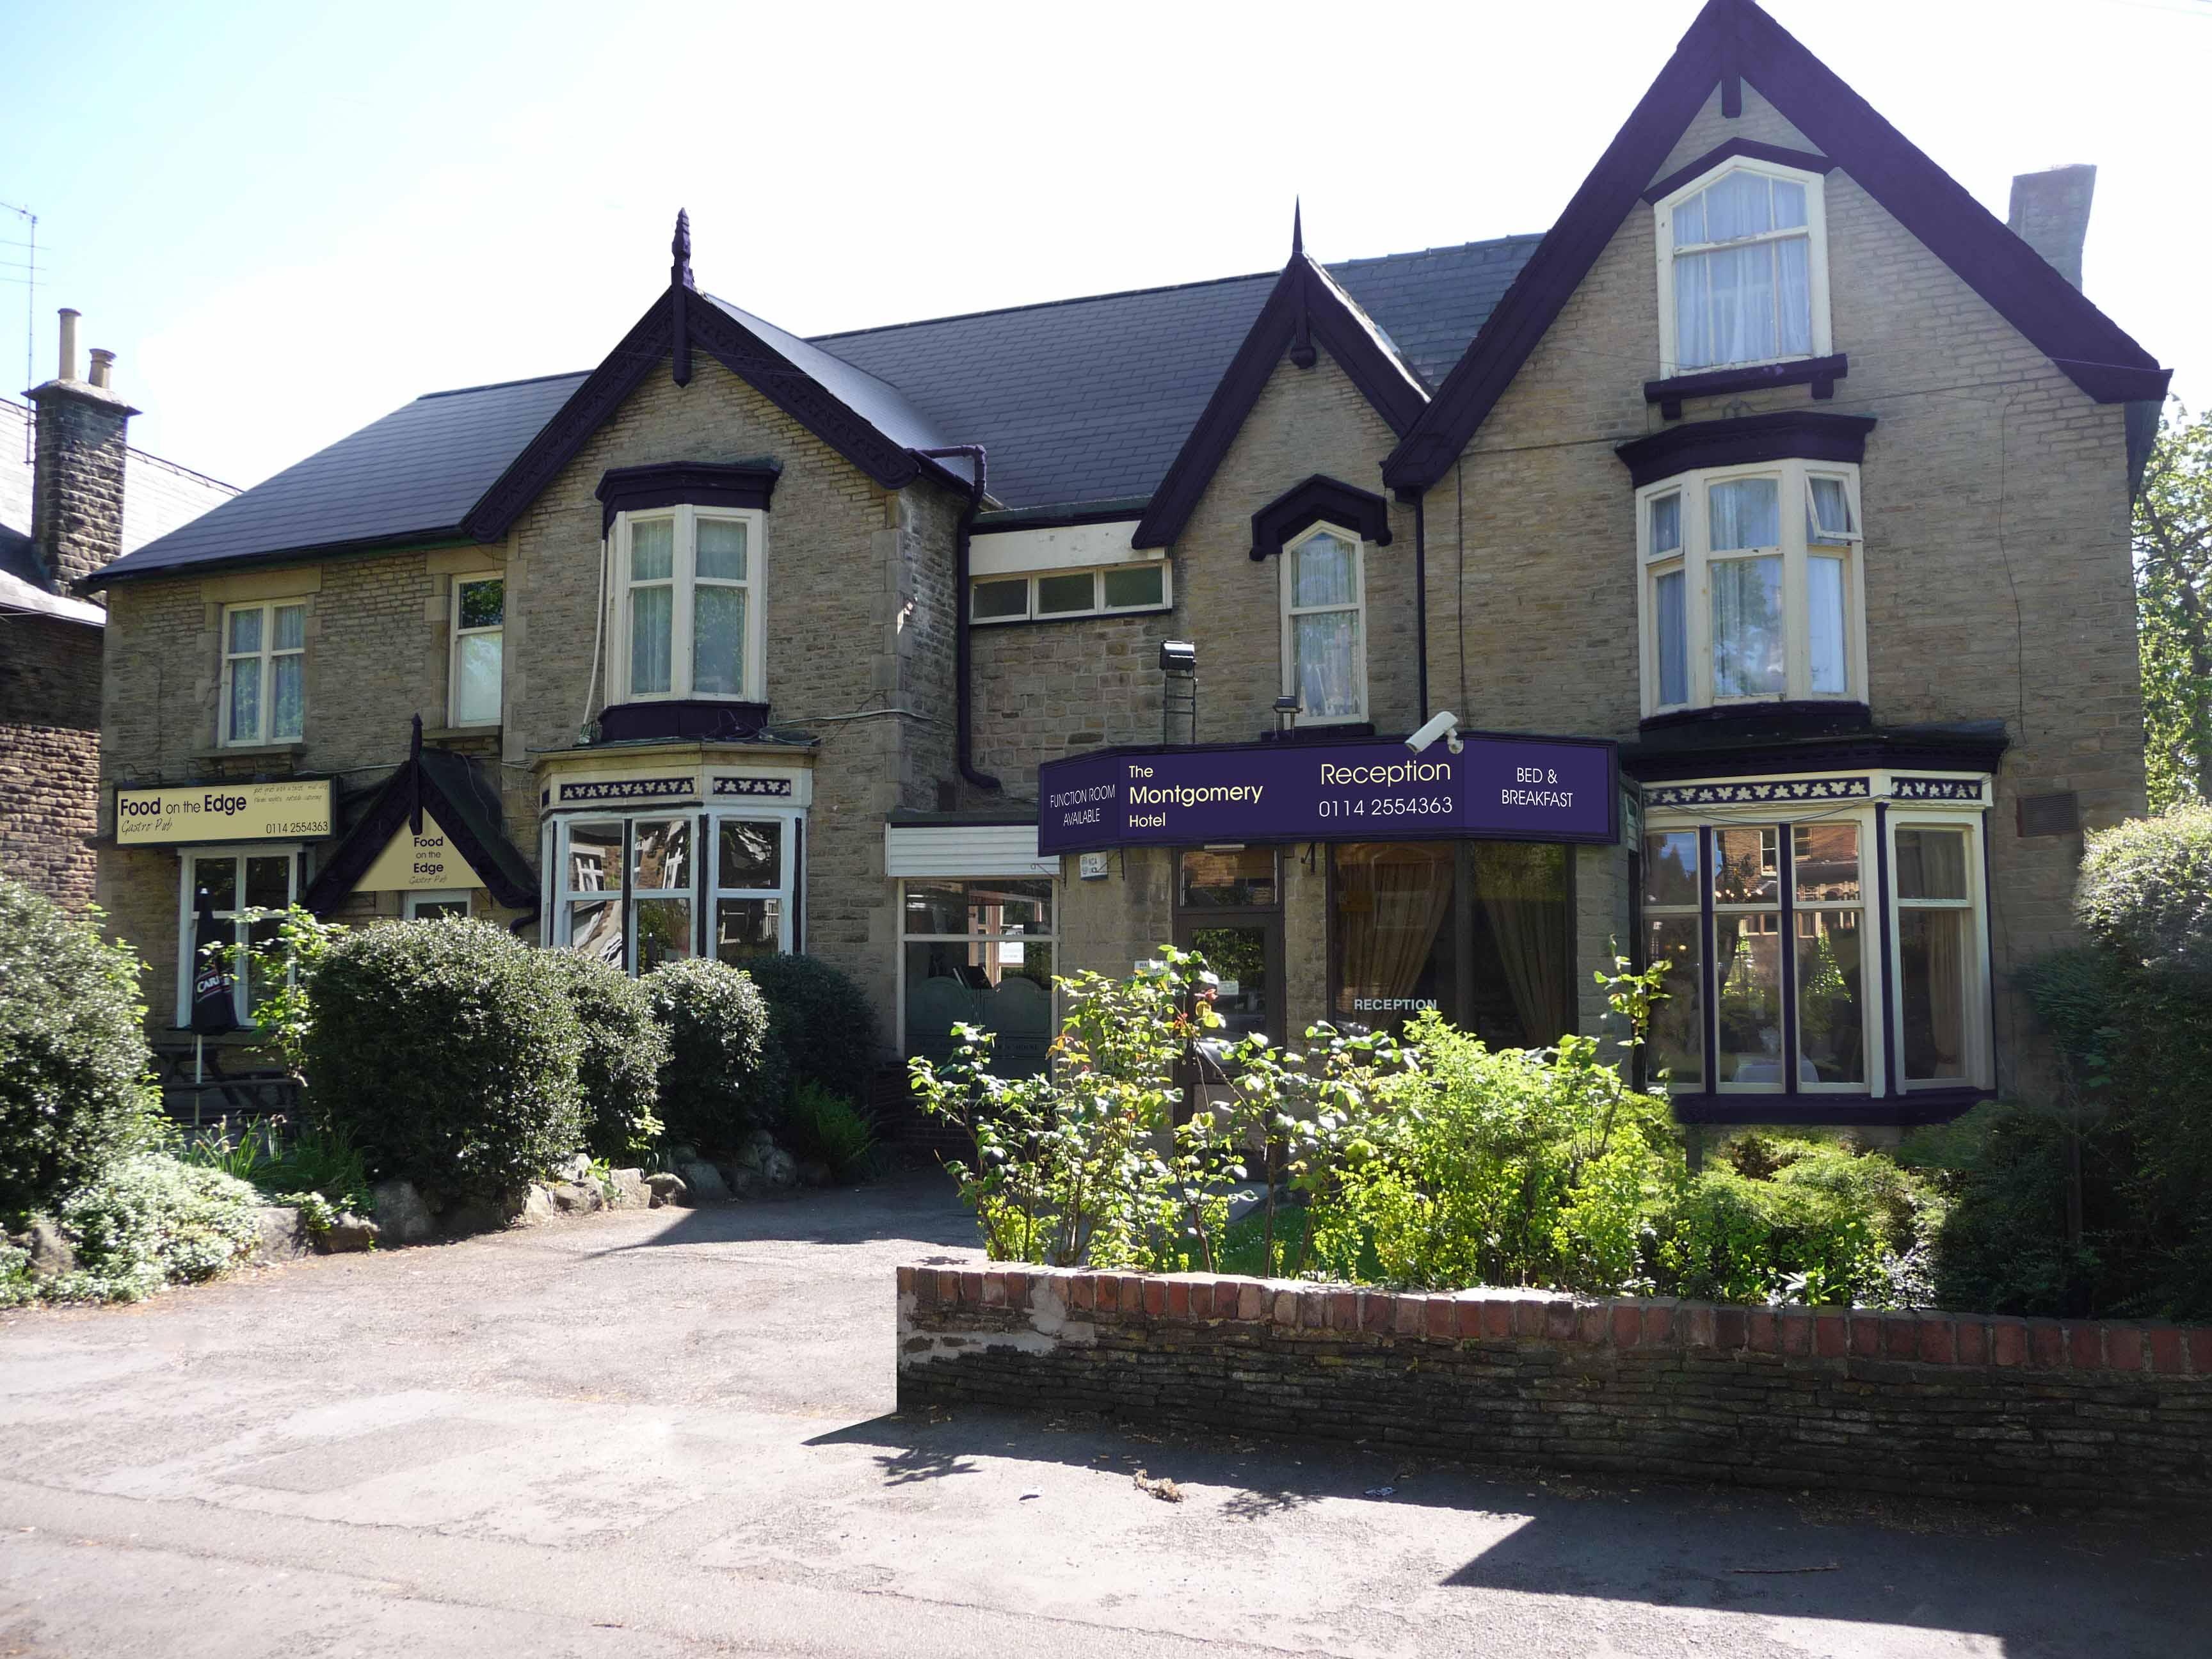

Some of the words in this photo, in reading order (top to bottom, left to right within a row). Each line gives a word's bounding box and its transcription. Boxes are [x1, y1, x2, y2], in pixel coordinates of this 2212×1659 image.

[1128, 765, 1153, 778] The
[1320, 760, 1451, 787] Reception
[1517, 767, 1543, 783] BED
[1547, 769, 1558, 784] &
[120, 797, 161, 816] Food
[166, 803, 180, 814] on
[183, 801, 201, 813] the
[204, 794, 247, 816] Edge
[1050, 789, 1087, 808] FUNCTION
[1089, 784, 1115, 801] ROOM
[1129, 785, 1263, 807] Montgomery
[1502, 789, 1573, 807] BREAKFAST
[1319, 800, 1365, 817] 0114
[1372, 797, 1453, 815] 2554363
[121, 819, 152, 835] Gastro
[155, 817, 173, 831] Pub
[1063, 808, 1100, 827] AVAILABLE
[1129, 812, 1166, 828] Hotel
[266, 823, 287, 834] 0114
[290, 821, 328, 833] 2554363
[414, 836, 443, 847] Food
[413, 862, 444, 875] Edge
[1354, 999, 1437, 1011] RECEPTION
